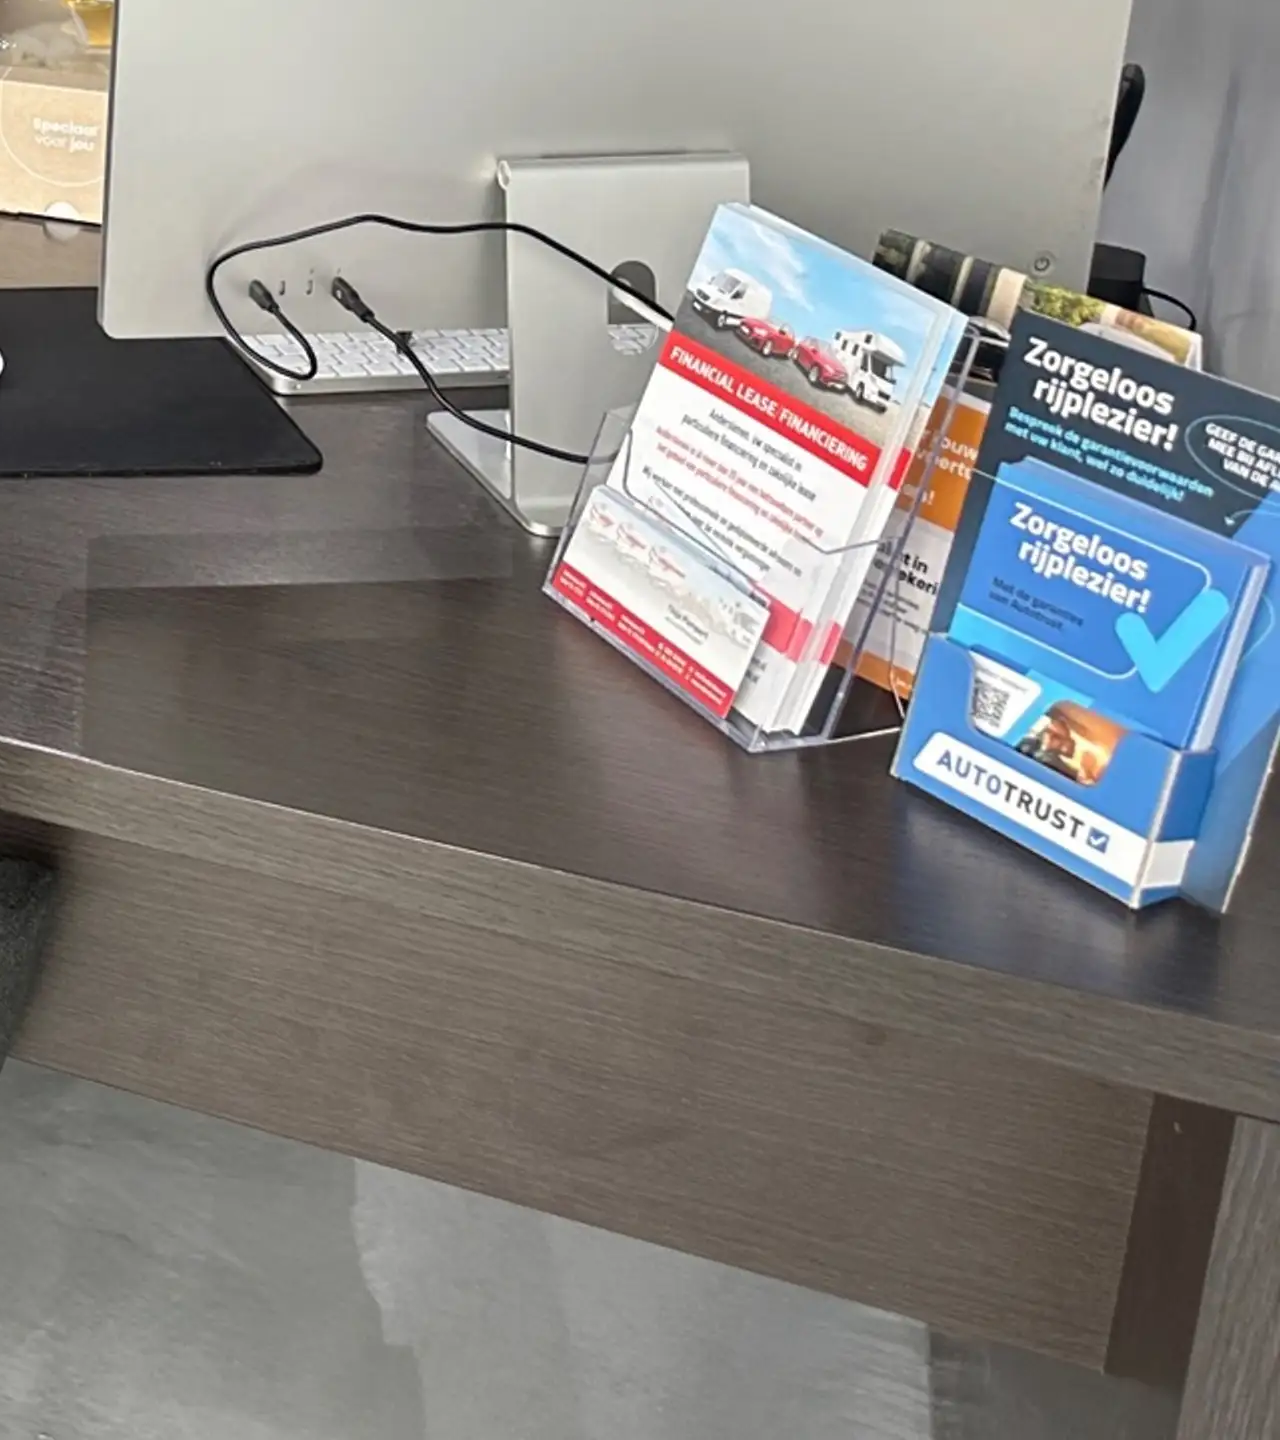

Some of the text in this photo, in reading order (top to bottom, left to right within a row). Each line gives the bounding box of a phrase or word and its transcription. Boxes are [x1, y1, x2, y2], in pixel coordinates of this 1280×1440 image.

[669, 345, 736, 394] FINANCIAL
[736, 383, 777, 418] LEASE
[778, 408, 870, 472] FINANCIERING
[1024, 336, 1175, 415] Zorgeloos
[1005, 420, 1028, 440] met
[1033, 378, 1179, 452] rijplezier!
[1064, 428, 1080, 444] de
[1205, 422, 1239, 442] GEEF
[1238, 436, 1257, 453] DE
[1207, 438, 1236, 458] MEE
[1223, 458, 1250, 479] VAN
[1009, 501, 1149, 581] Zorgeloos
[1018, 541, 1152, 613] rijplezier!
[936, 749, 1085, 839] AUTOTRUST
